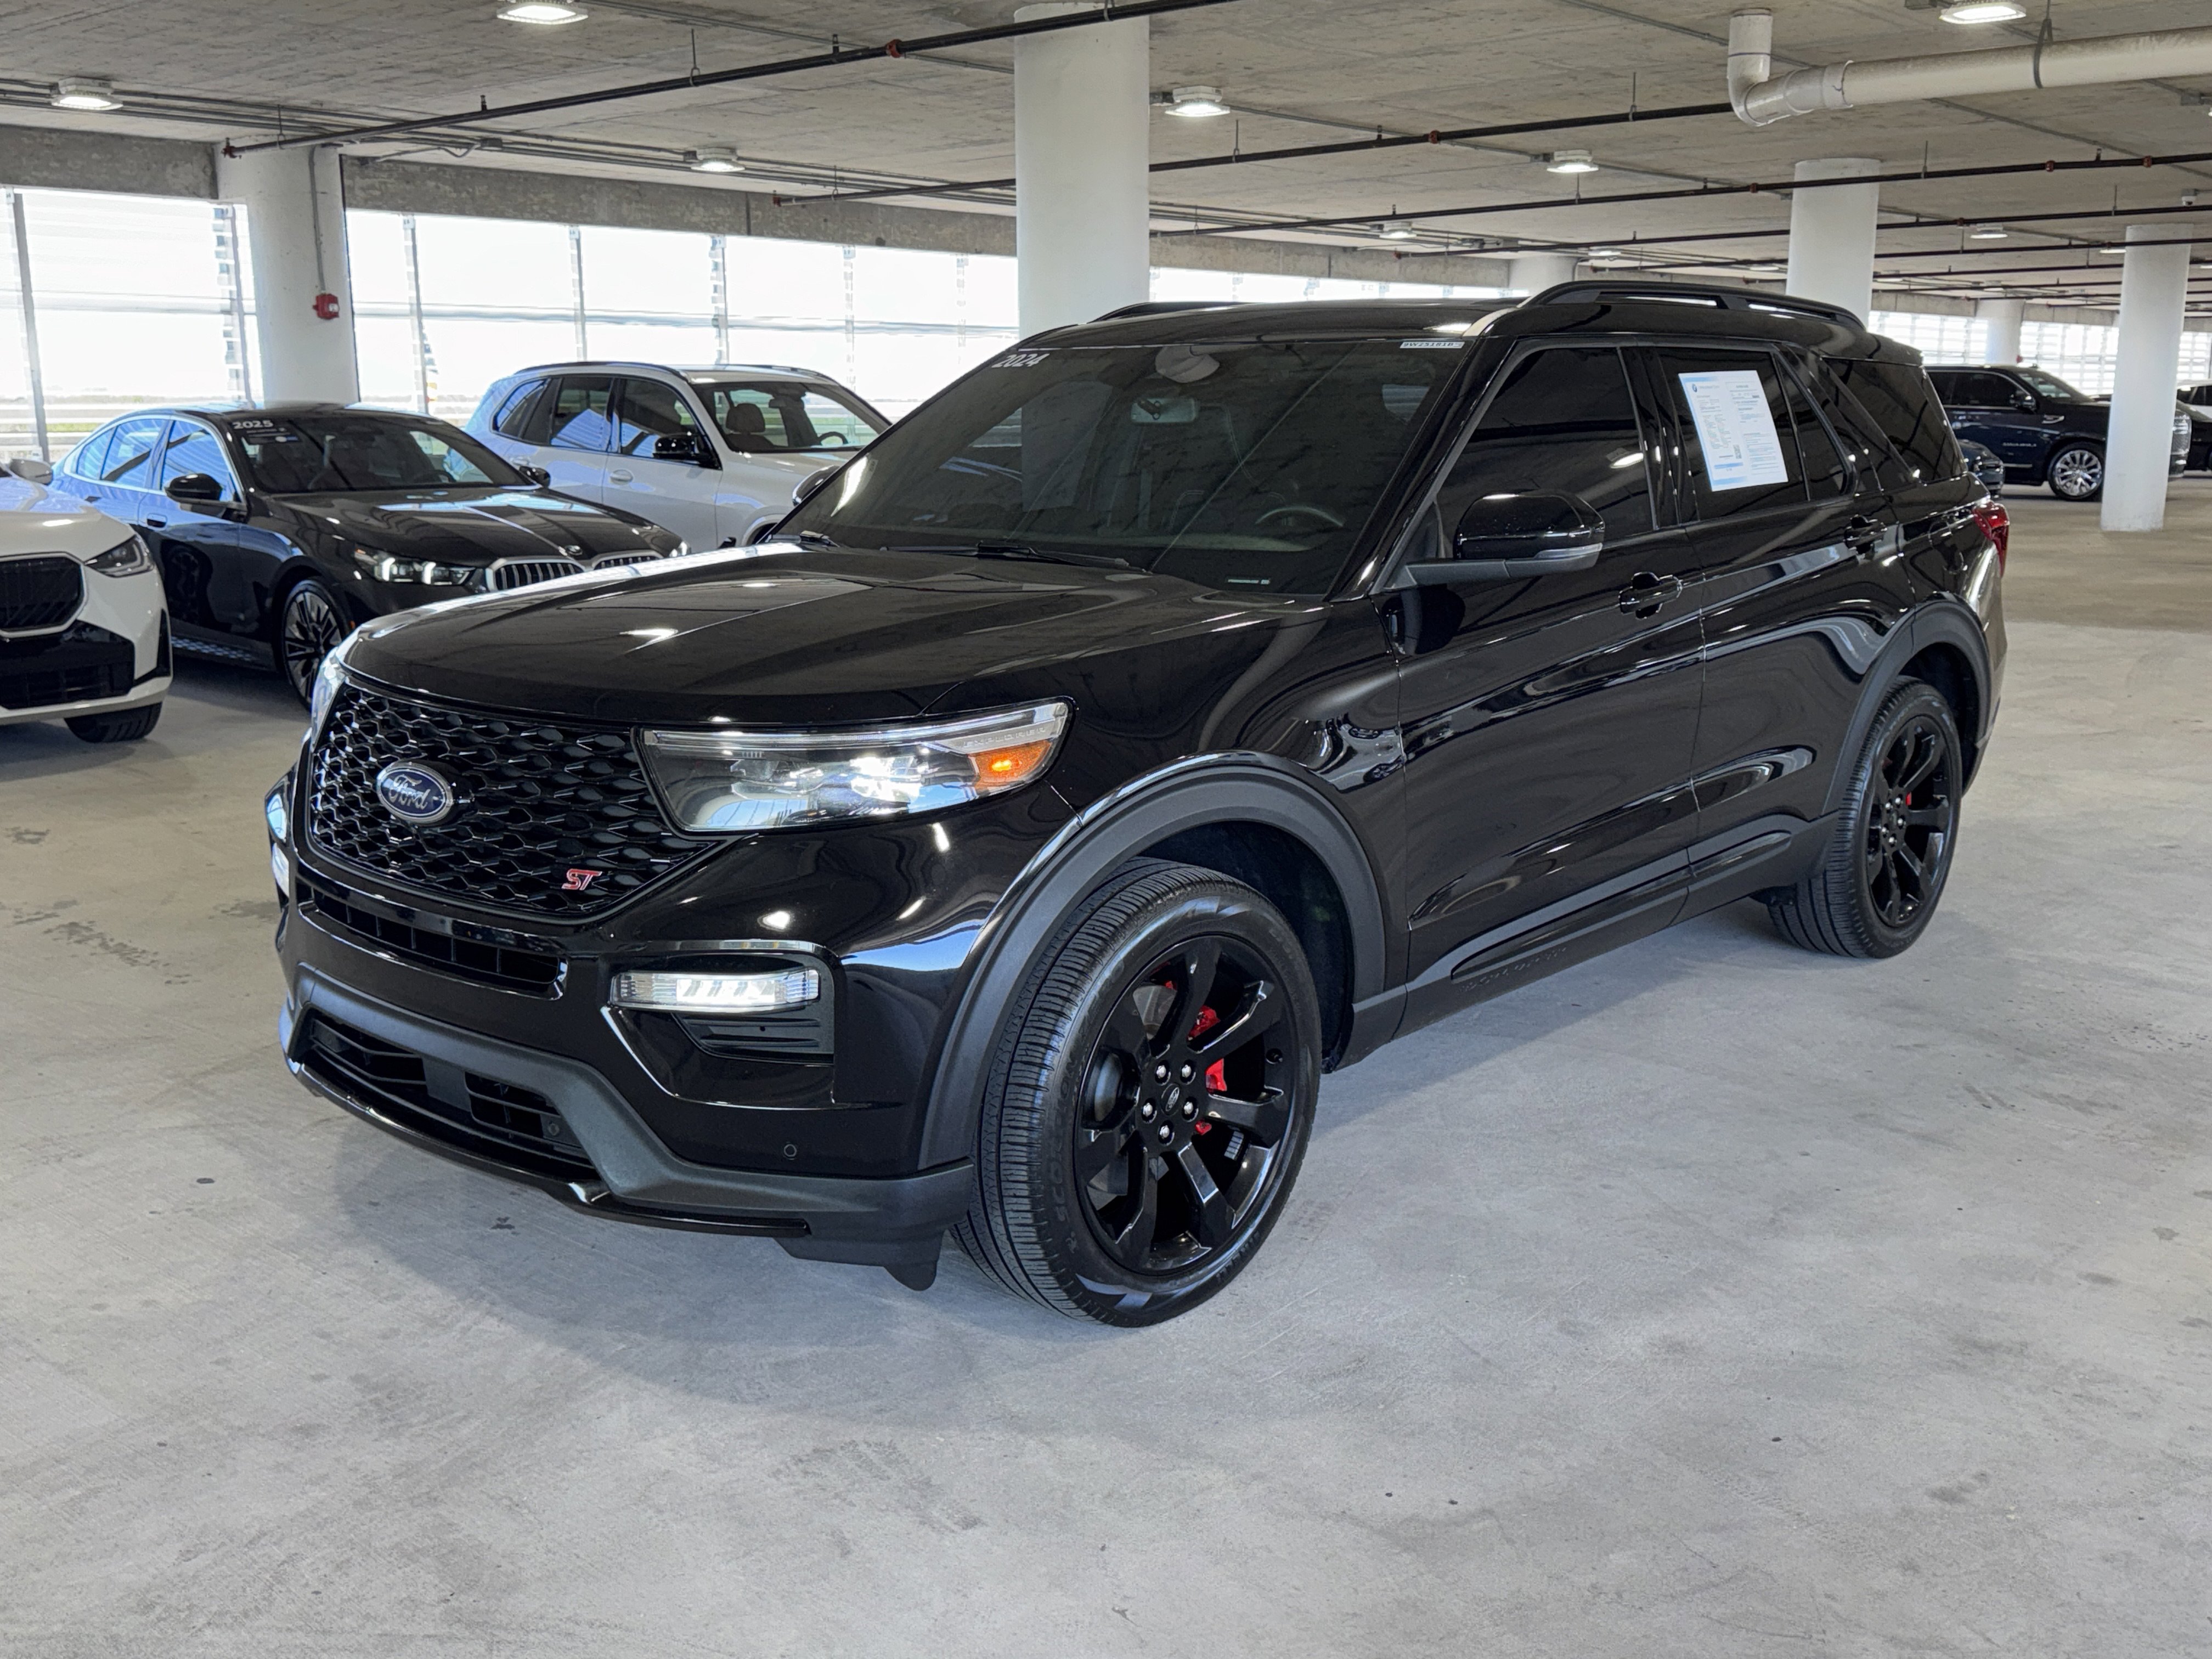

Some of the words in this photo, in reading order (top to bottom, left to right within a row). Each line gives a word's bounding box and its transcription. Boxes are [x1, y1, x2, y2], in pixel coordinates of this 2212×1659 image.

[991, 353, 1050, 368] 2024
[232, 420, 274, 429] 2025
[388, 774, 431, 810] Ford
[561, 868, 602, 890] ST
